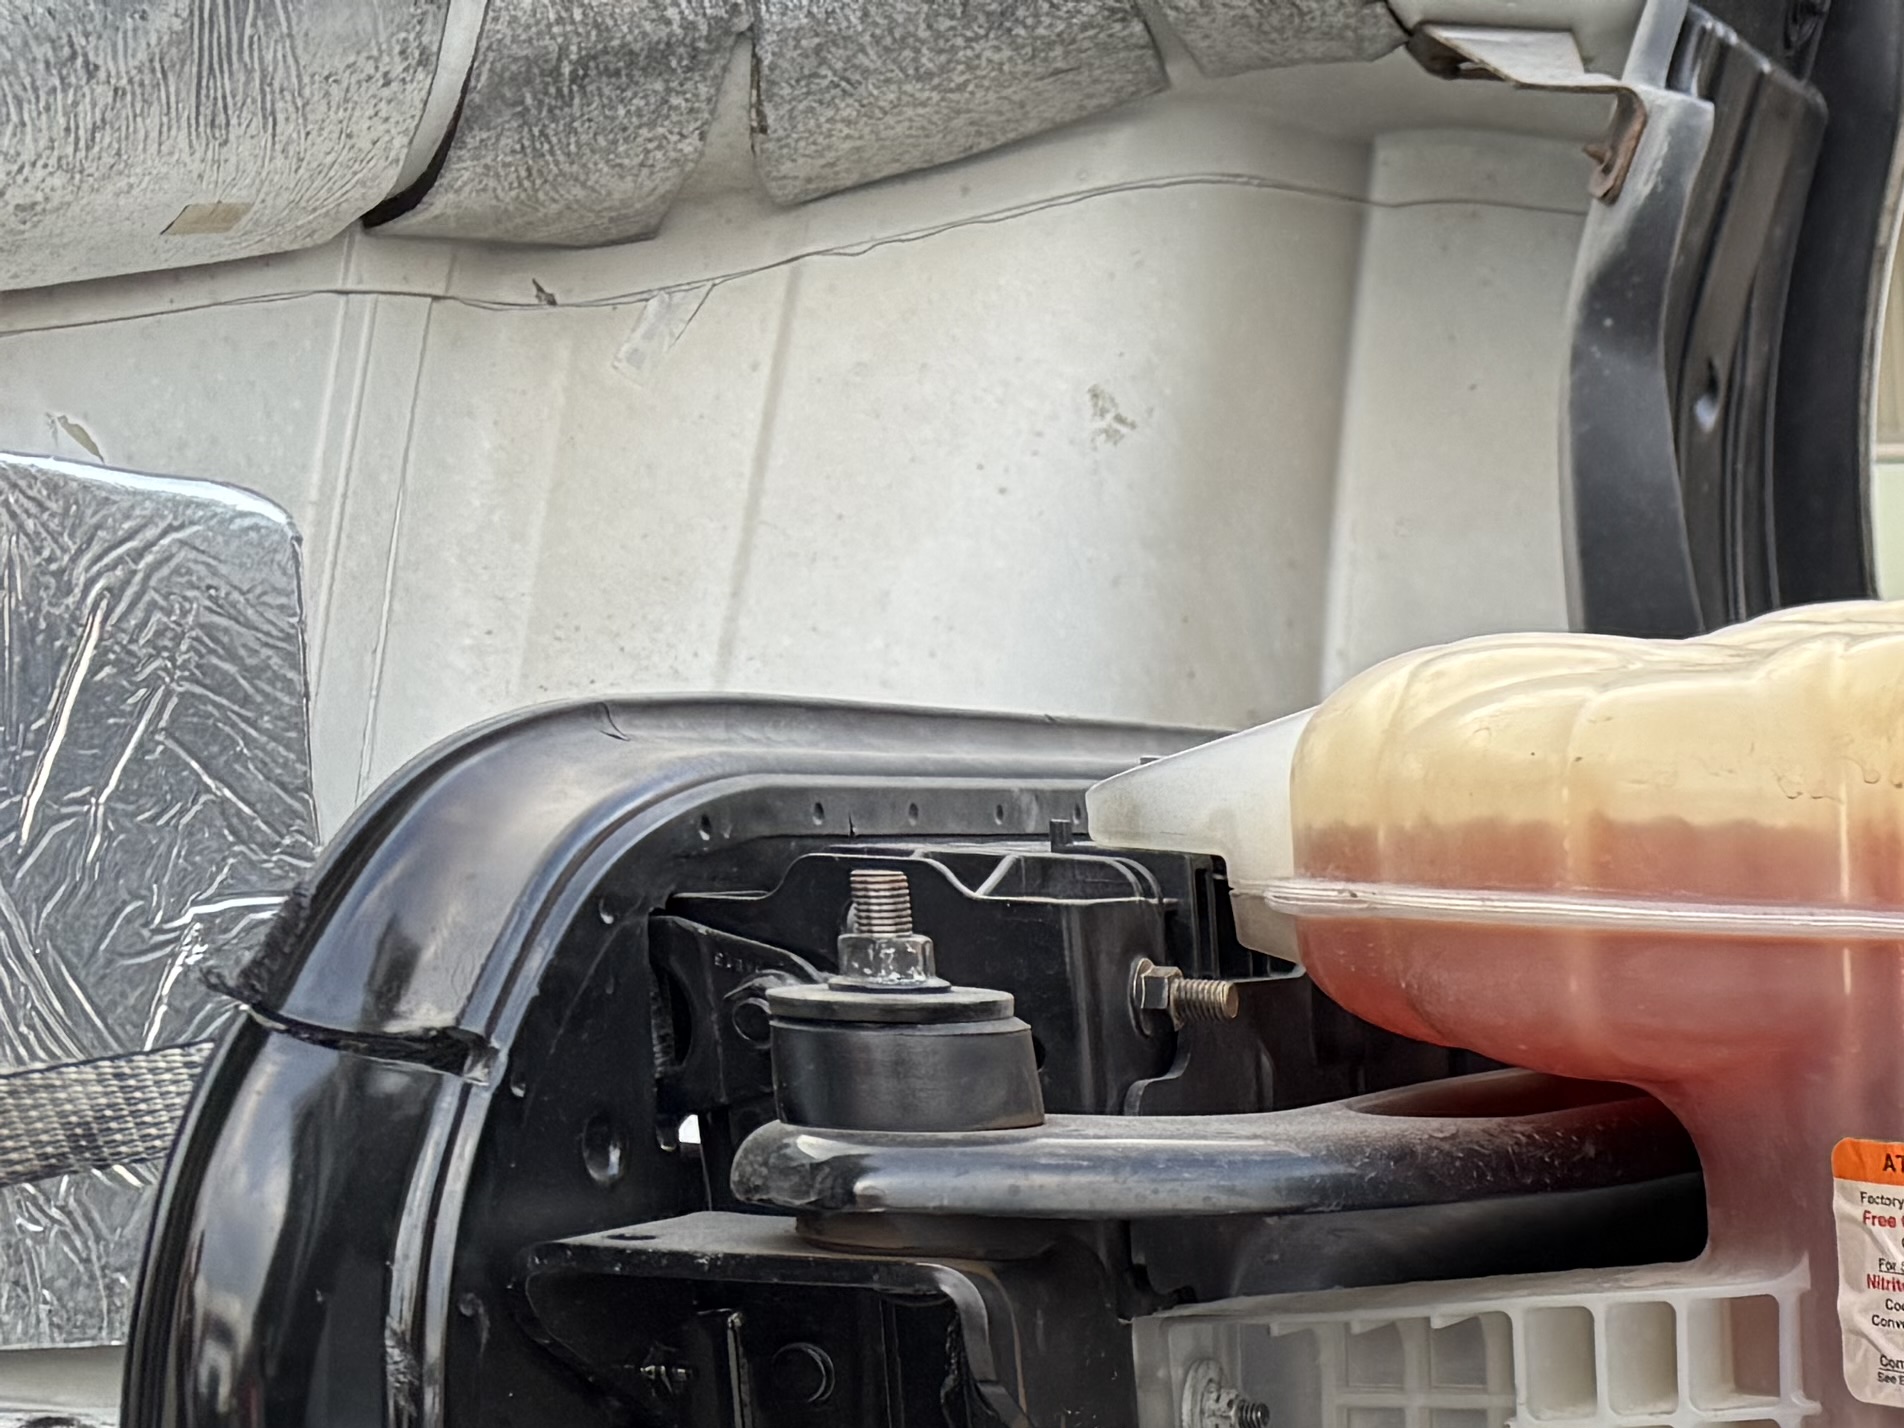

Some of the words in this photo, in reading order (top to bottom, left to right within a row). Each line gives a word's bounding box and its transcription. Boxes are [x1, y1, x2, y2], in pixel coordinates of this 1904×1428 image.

[1860, 1191, 1904, 1210] Factory
[1863, 1210, 1897, 1228] Free
[1878, 1257, 1897, 1272] For
[1877, 1372, 1897, 1385] See
